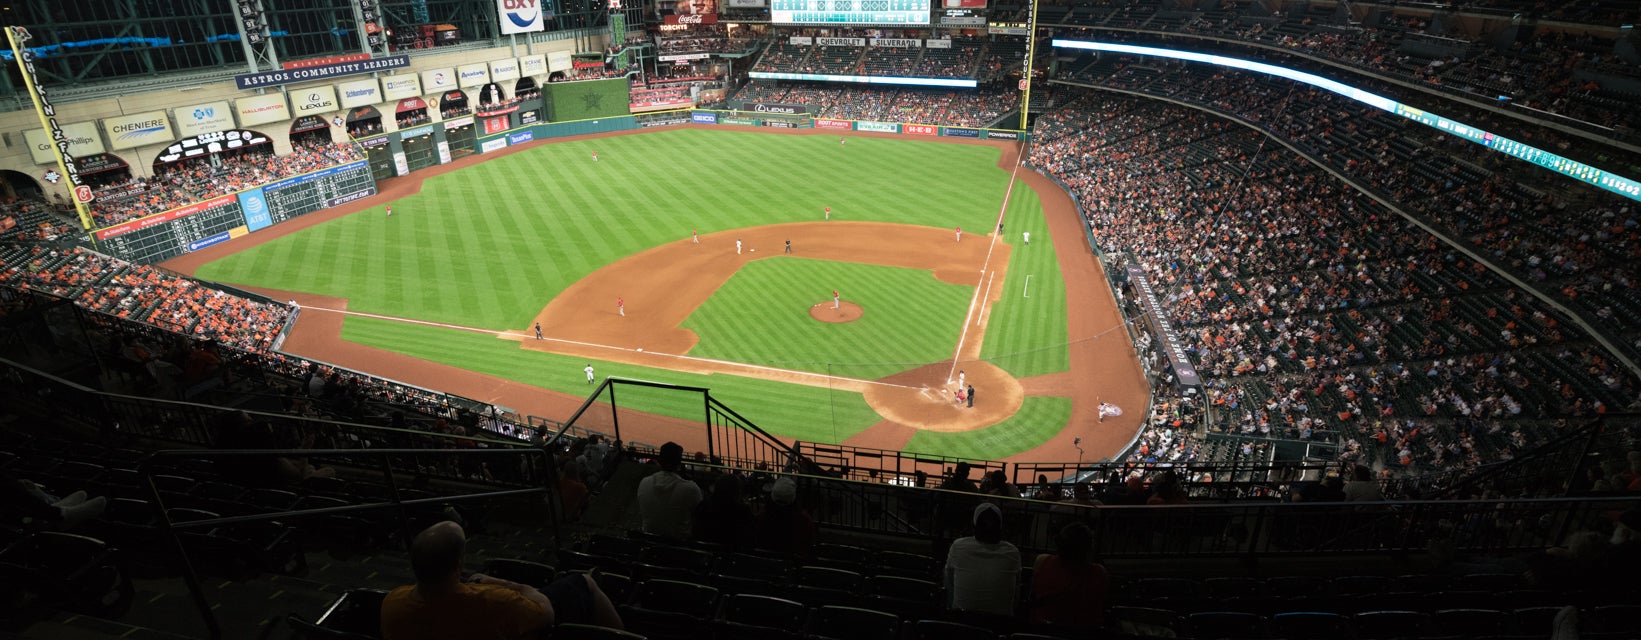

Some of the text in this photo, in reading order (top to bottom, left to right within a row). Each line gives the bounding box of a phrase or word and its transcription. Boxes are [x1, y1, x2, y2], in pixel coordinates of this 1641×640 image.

[504, 0, 535, 10] OXY
[678, 15, 702, 24] Coca-Cola
[820, 38, 860, 46] CHEVROLET
[293, 60, 360, 79] COMMUNITY
[363, 57, 405, 70] LEADERS
[345, 88, 375, 98] Schlumberger
[242, 104, 284, 115] HALLIBURTON
[300, 101, 332, 111] LEXUS
[113, 119, 164, 133] CHENIERE
[511, 133, 532, 143] TexanPlus
[57, 141, 82, 185] FARE
[96, 190, 127, 203] CRAWFORD
[250, 213, 267, 225] AT&T
[1171, 343, 1187, 363] HOME
